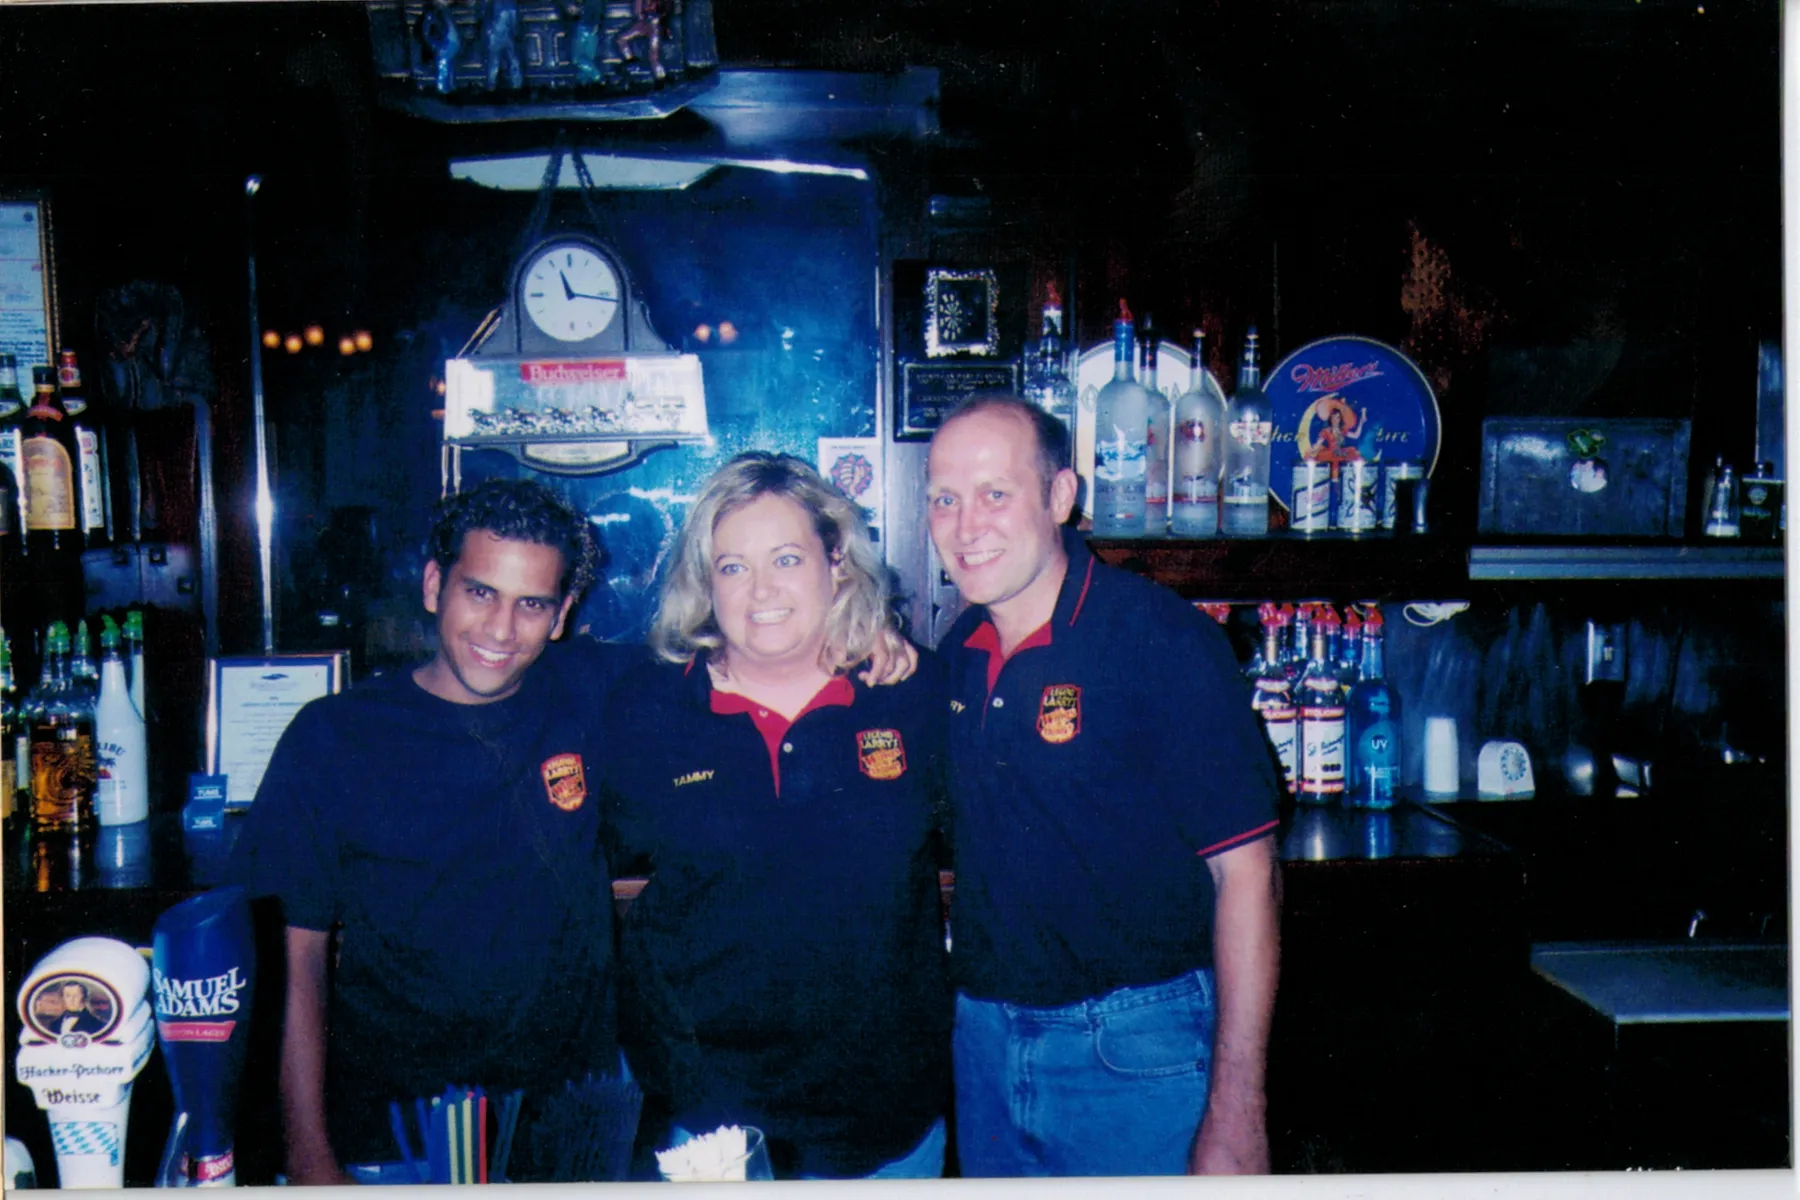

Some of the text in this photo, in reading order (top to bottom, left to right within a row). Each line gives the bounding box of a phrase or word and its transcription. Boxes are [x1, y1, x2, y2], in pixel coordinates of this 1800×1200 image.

[529, 364, 621, 382] Budweiser
[1290, 360, 1384, 392] Miller
[1370, 739, 1388, 750] UV
[673, 769, 715, 788] TAMMY
[153, 966, 247, 1000] SAMUEL
[156, 991, 240, 1016] ADAMS
[41, 1087, 101, 1105] Weisse
